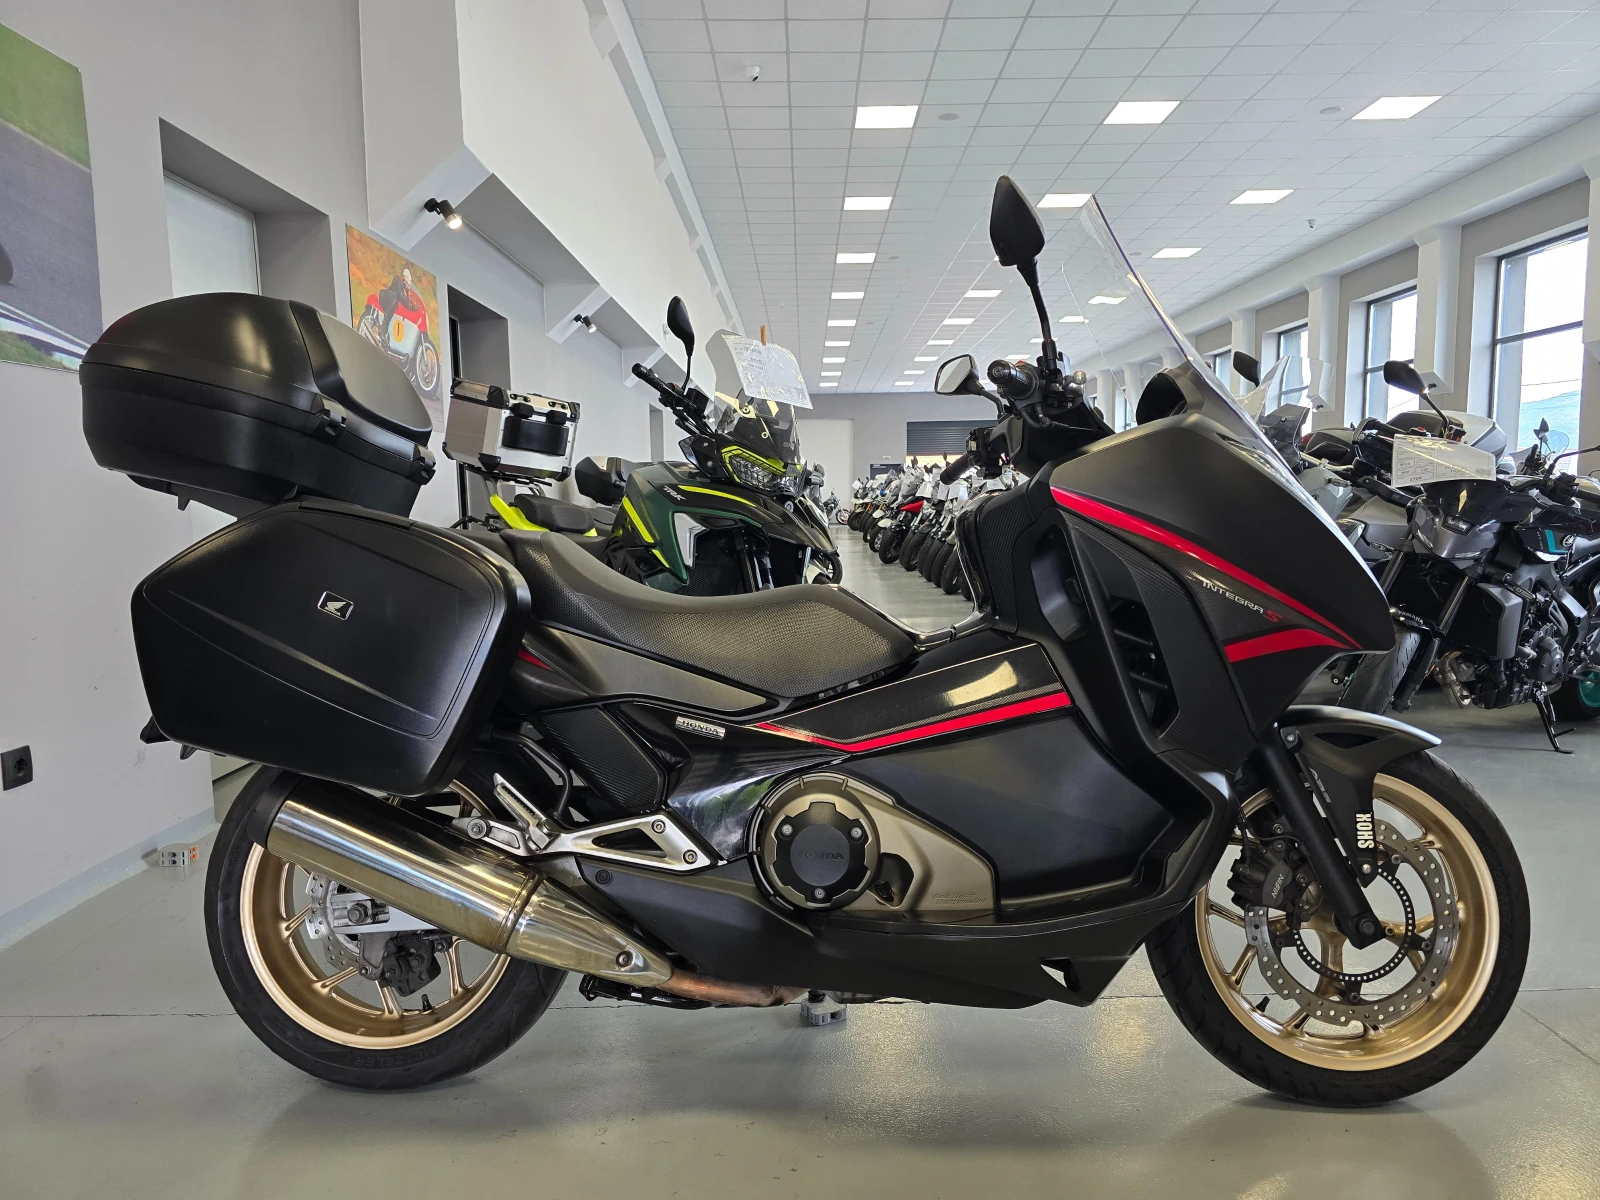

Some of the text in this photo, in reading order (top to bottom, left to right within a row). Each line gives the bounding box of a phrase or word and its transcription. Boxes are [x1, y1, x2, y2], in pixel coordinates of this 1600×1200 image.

[663, 485, 686, 500] TRK
[1202, 581, 1283, 623] INTEGRA S
[1398, 609, 1424, 625] YAMAHA
[682, 720, 719, 734] HONDA
[1356, 813, 1375, 849] SHOX
[794, 851, 845, 861] HONDA
